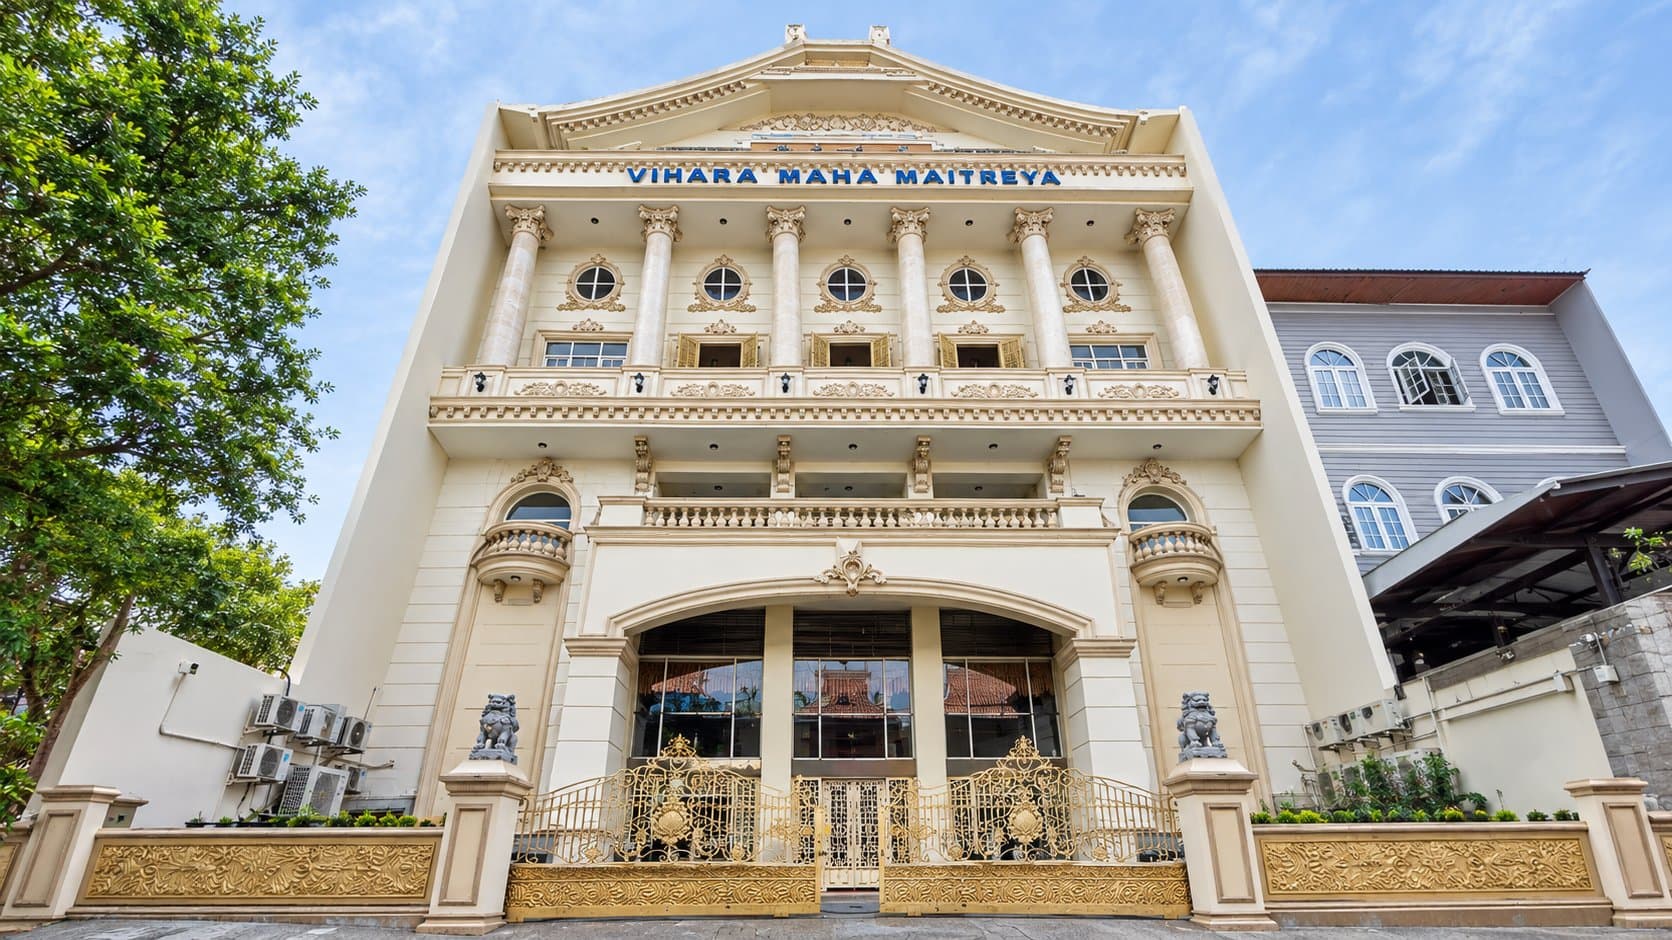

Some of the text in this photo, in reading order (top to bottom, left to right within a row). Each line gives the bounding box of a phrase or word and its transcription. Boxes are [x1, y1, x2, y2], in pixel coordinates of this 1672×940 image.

[627, 168, 1061, 185] VIHARA MAHA MAITREYA
